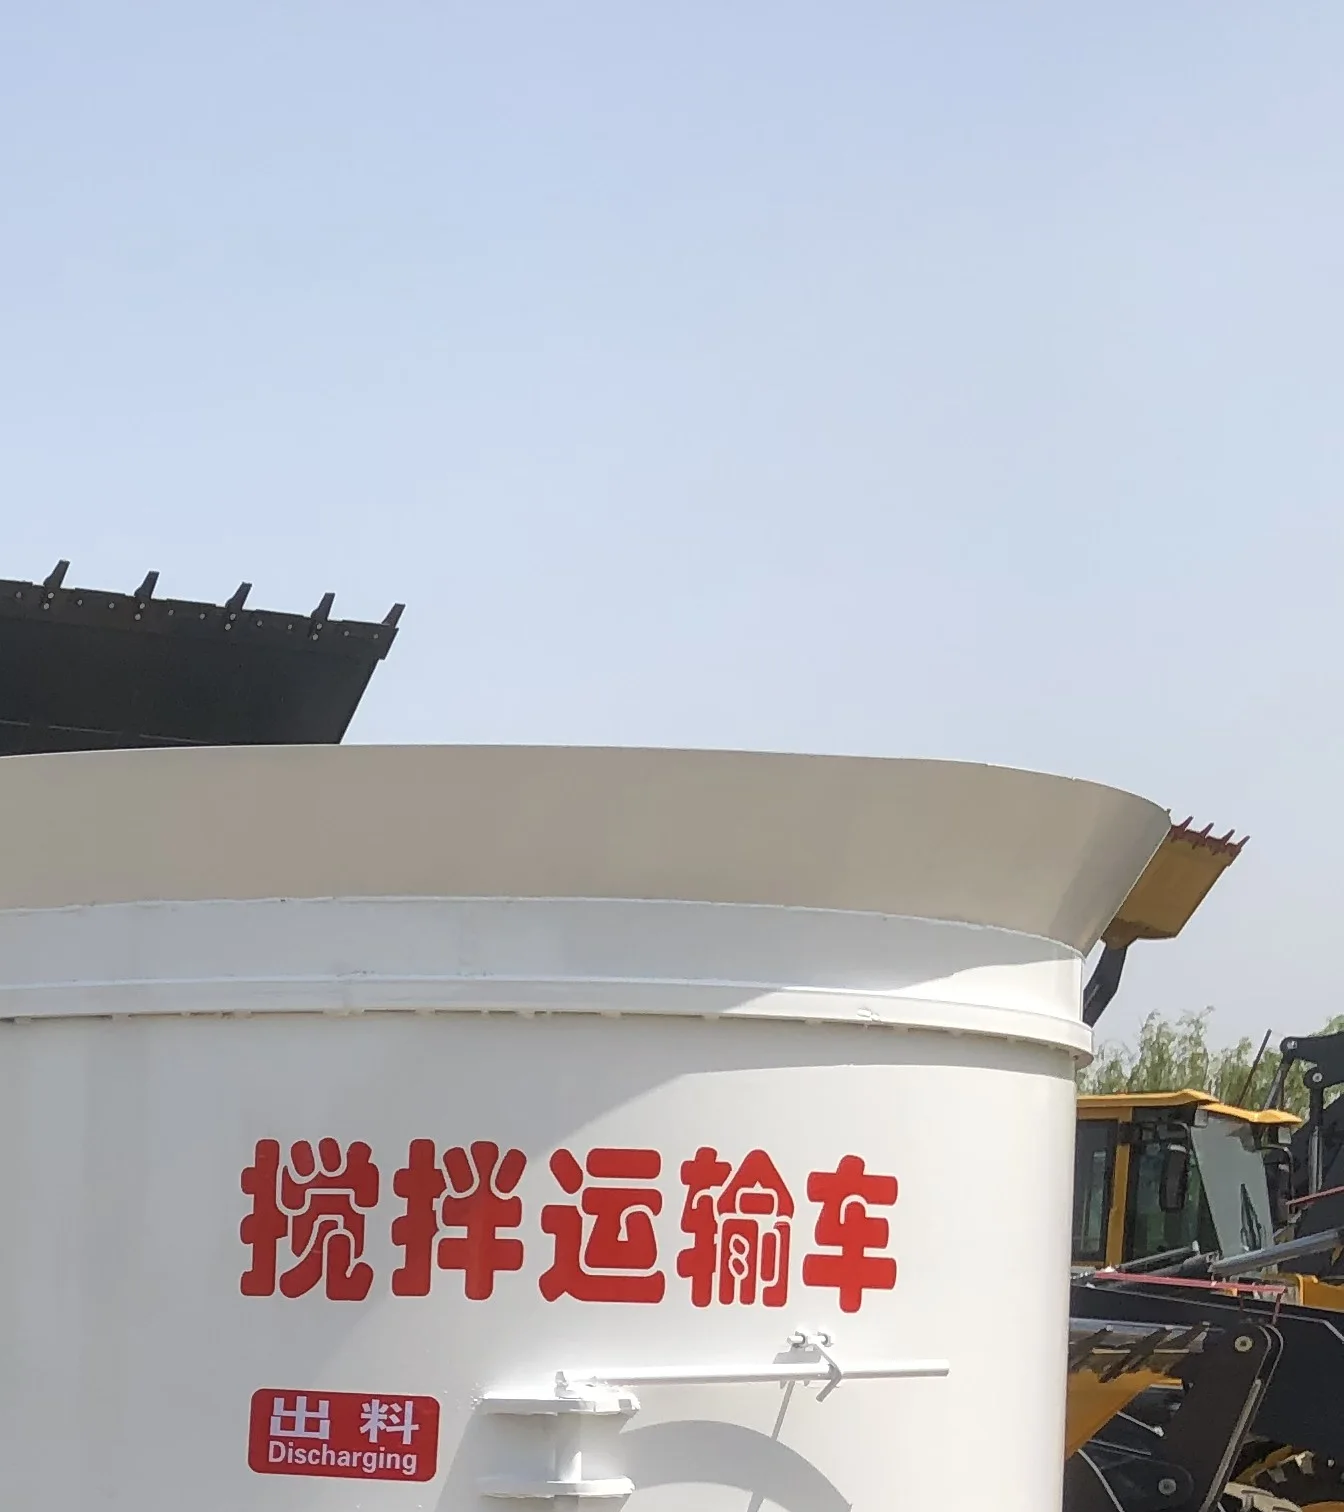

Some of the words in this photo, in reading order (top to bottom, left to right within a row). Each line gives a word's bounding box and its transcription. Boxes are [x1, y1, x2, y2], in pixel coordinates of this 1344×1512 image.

[240, 1137, 898, 1313] 搅拌运输车
[269, 1395, 420, 1445] 出料
[267, 1439, 418, 1476] Discharging
